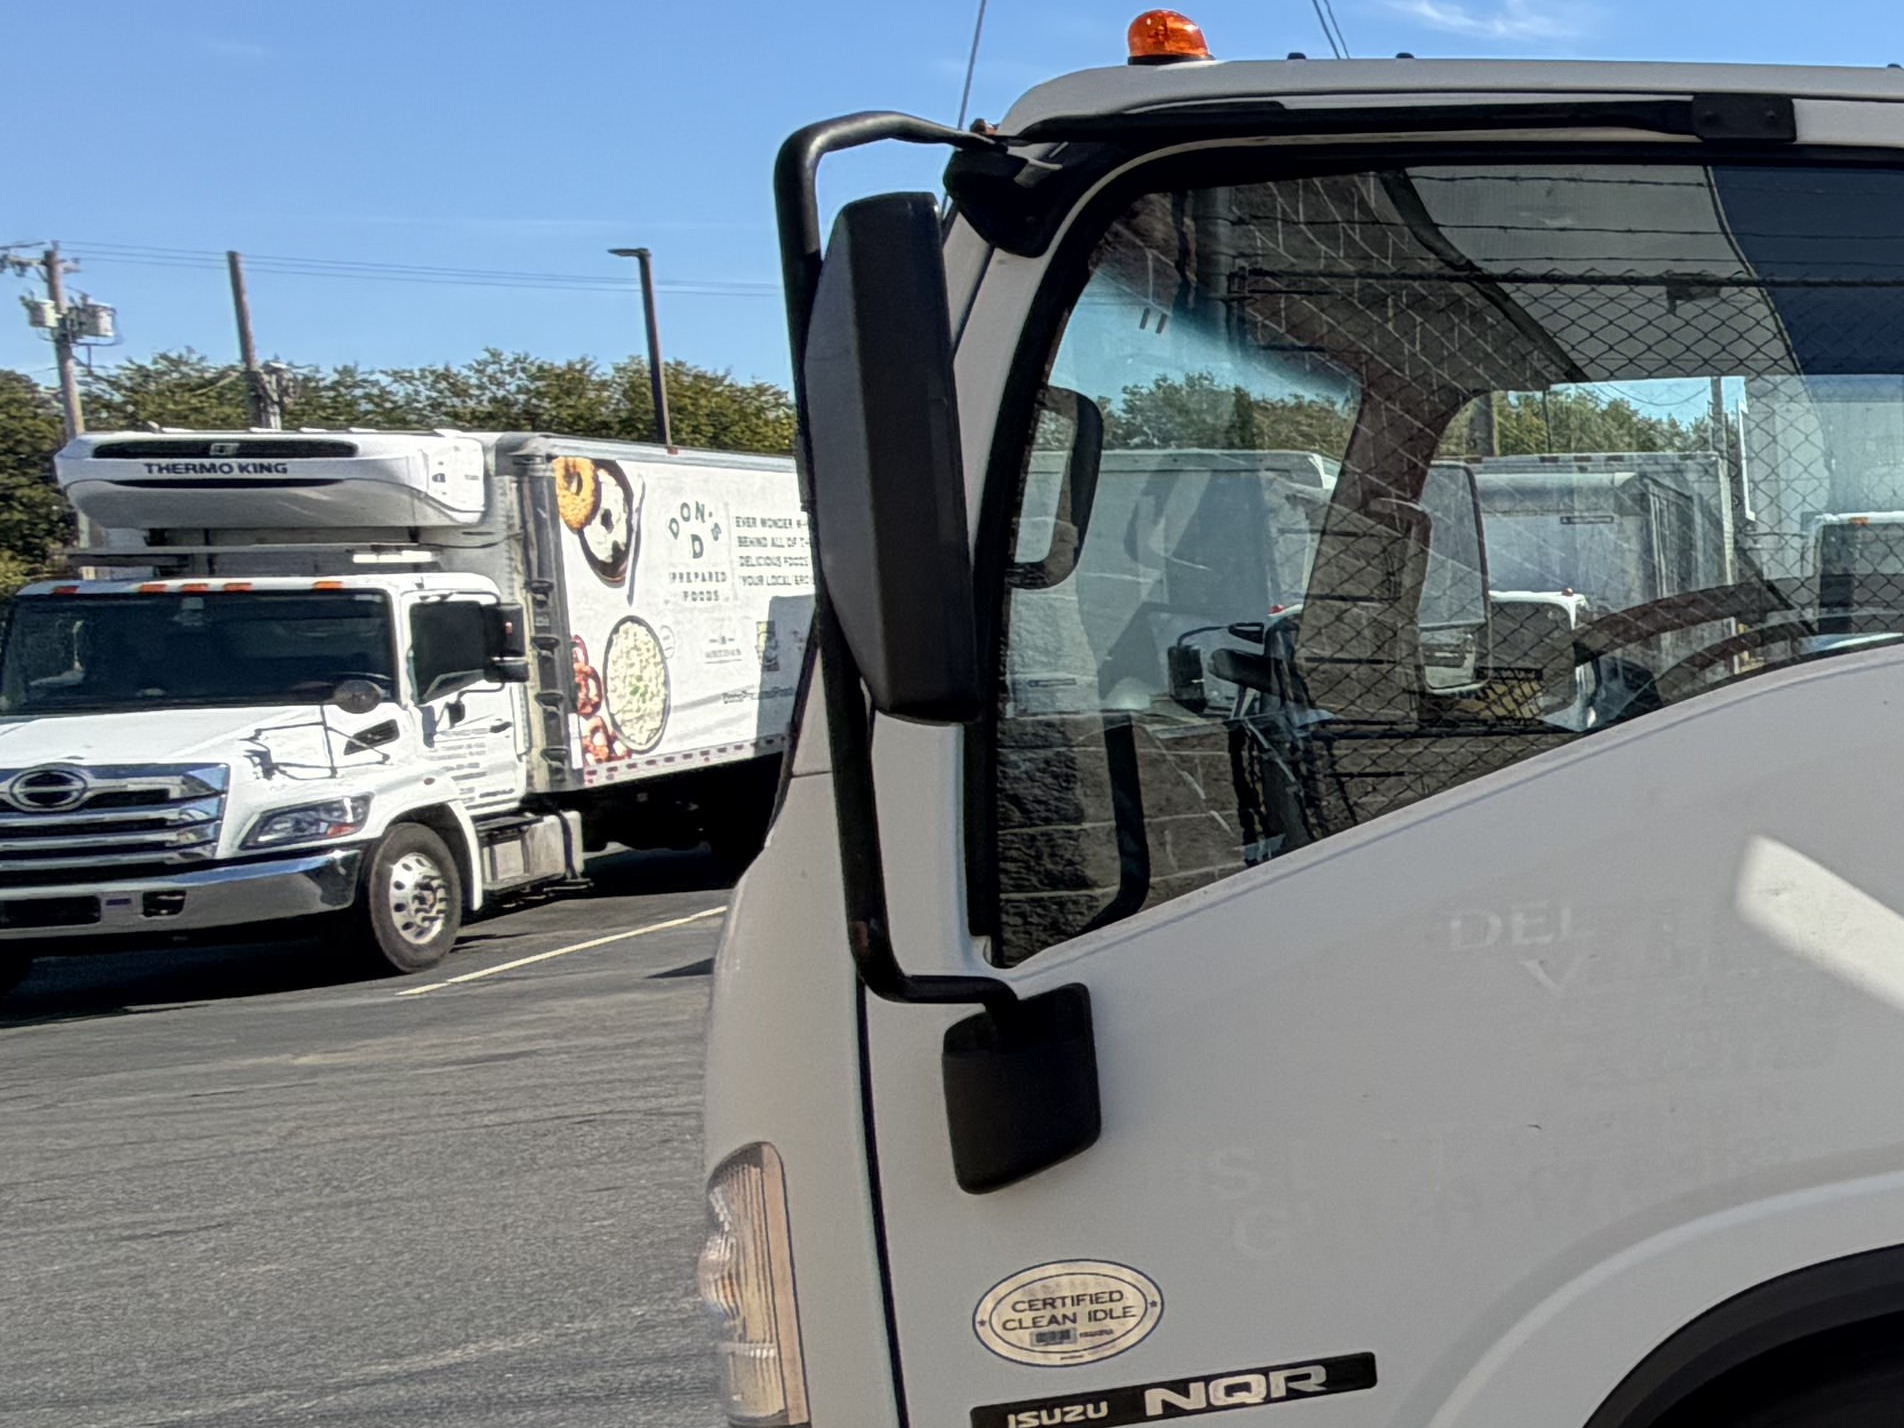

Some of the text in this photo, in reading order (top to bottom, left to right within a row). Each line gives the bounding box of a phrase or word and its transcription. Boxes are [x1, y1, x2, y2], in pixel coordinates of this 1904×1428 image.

[144, 462, 288, 475] THERMO KING
[670, 571, 727, 584] PREPARED
[683, 590, 720, 602] FOODS
[1011, 1289, 1124, 1313] CERTIFIED
[1001, 1305, 1138, 1332] CLEAN IDLE
[1143, 1364, 1327, 1418] NQR
